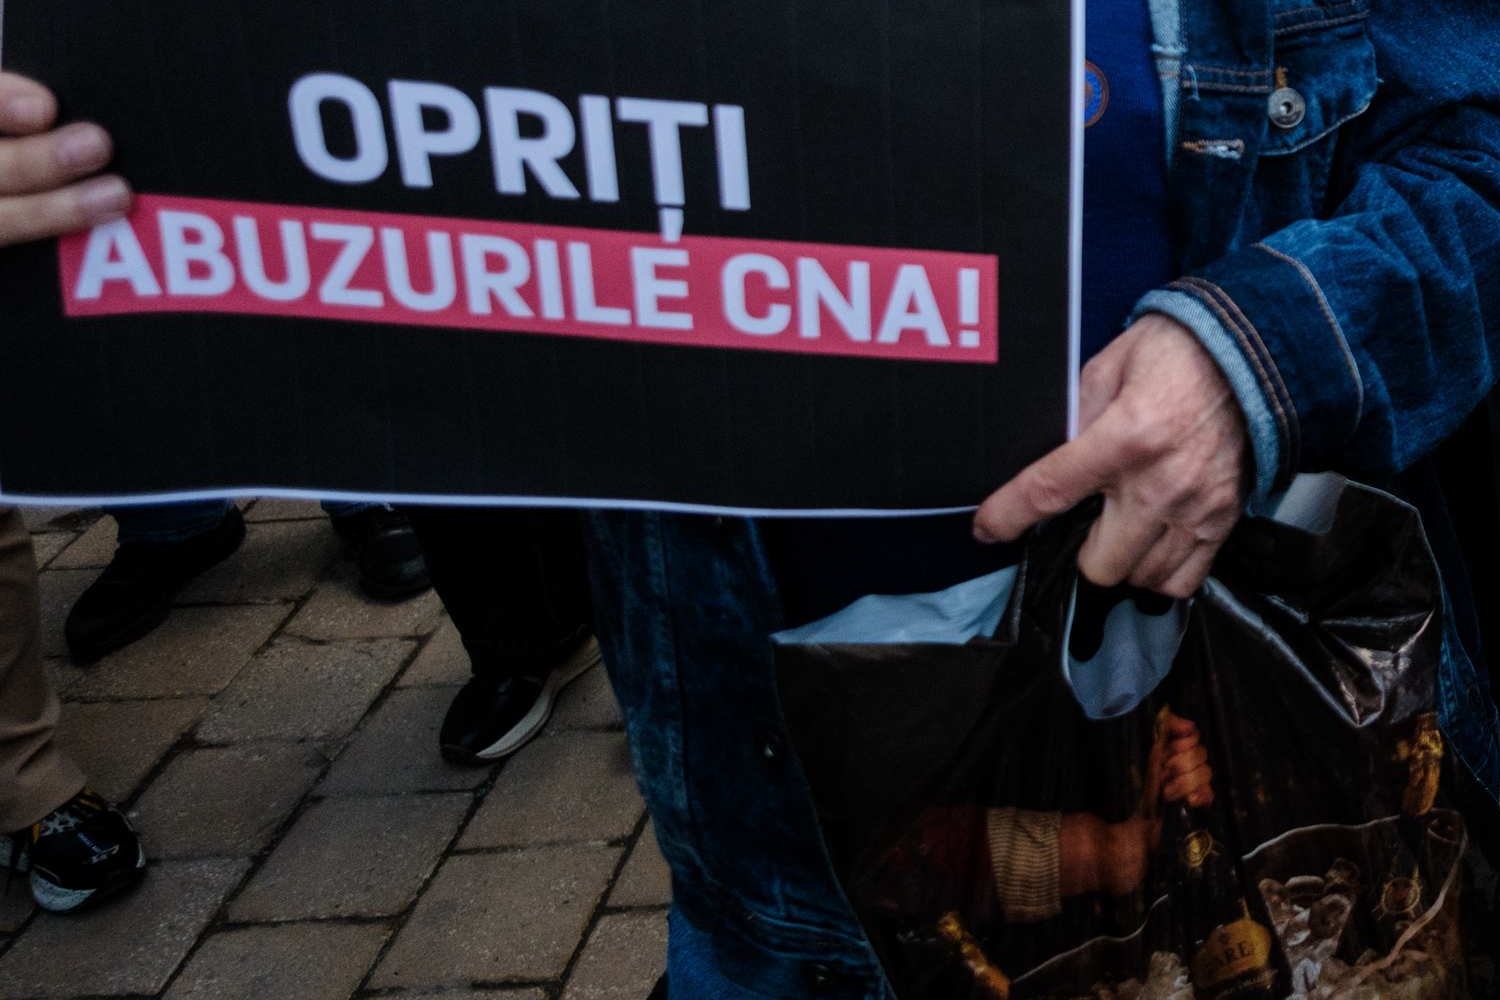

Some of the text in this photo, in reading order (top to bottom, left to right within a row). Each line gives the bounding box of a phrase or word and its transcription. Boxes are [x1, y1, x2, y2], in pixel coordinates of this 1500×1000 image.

[288, 72, 752, 243] OPRIȚI
[74, 209, 981, 348] ABUZURILE CNA!
